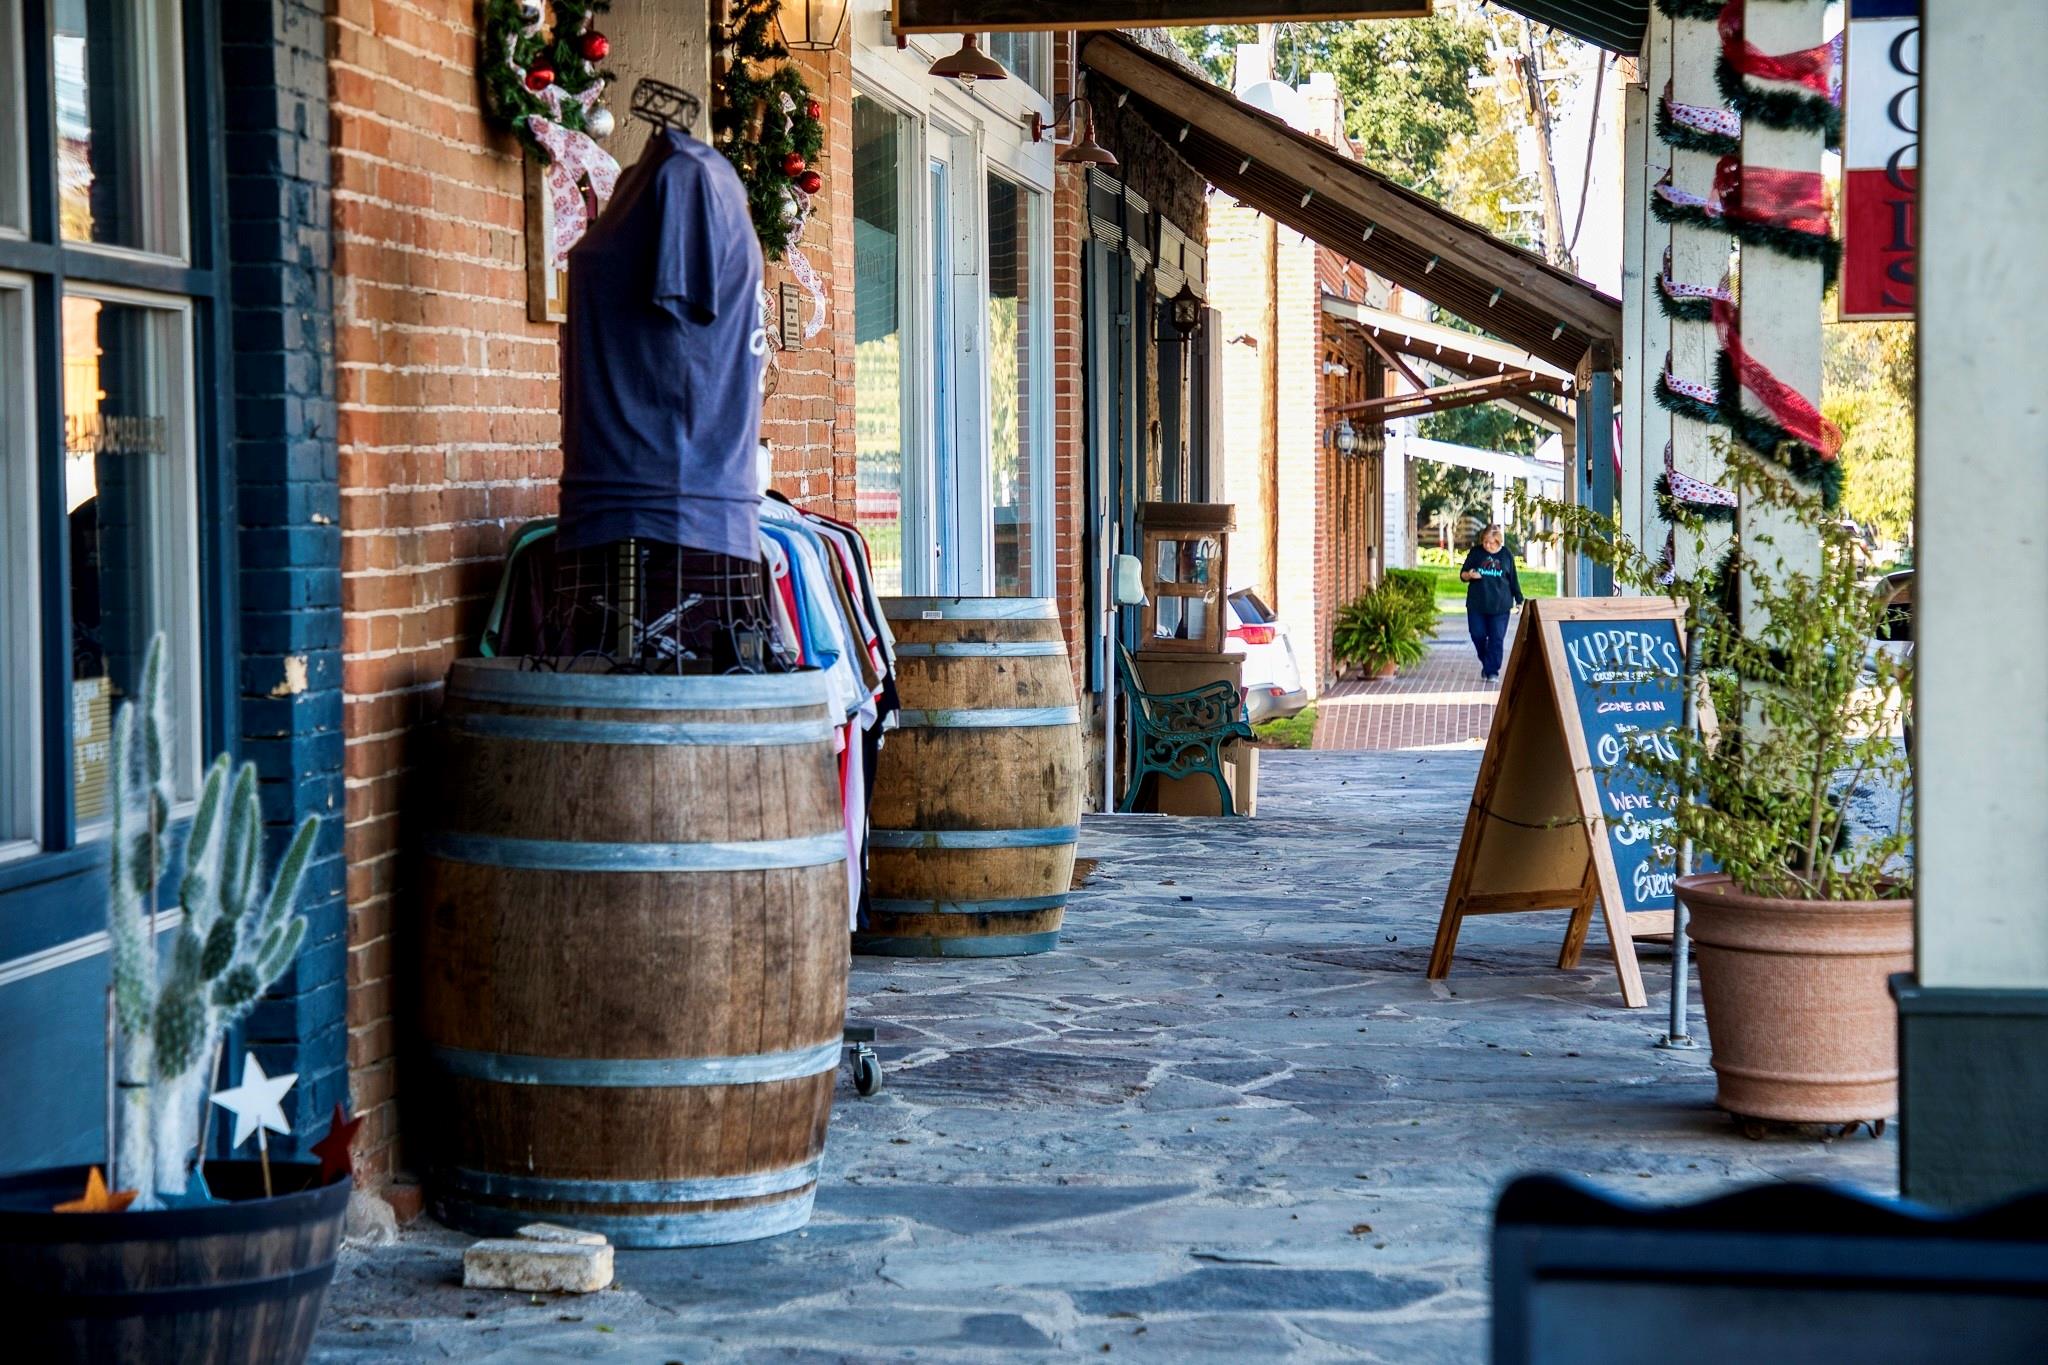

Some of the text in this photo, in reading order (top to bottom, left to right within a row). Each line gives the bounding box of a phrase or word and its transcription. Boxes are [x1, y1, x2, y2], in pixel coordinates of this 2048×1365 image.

[1567, 630, 1679, 681] KIPPER'S
[1597, 701, 1665, 714] COME ON IN
[1652, 843, 1676, 860] FO
